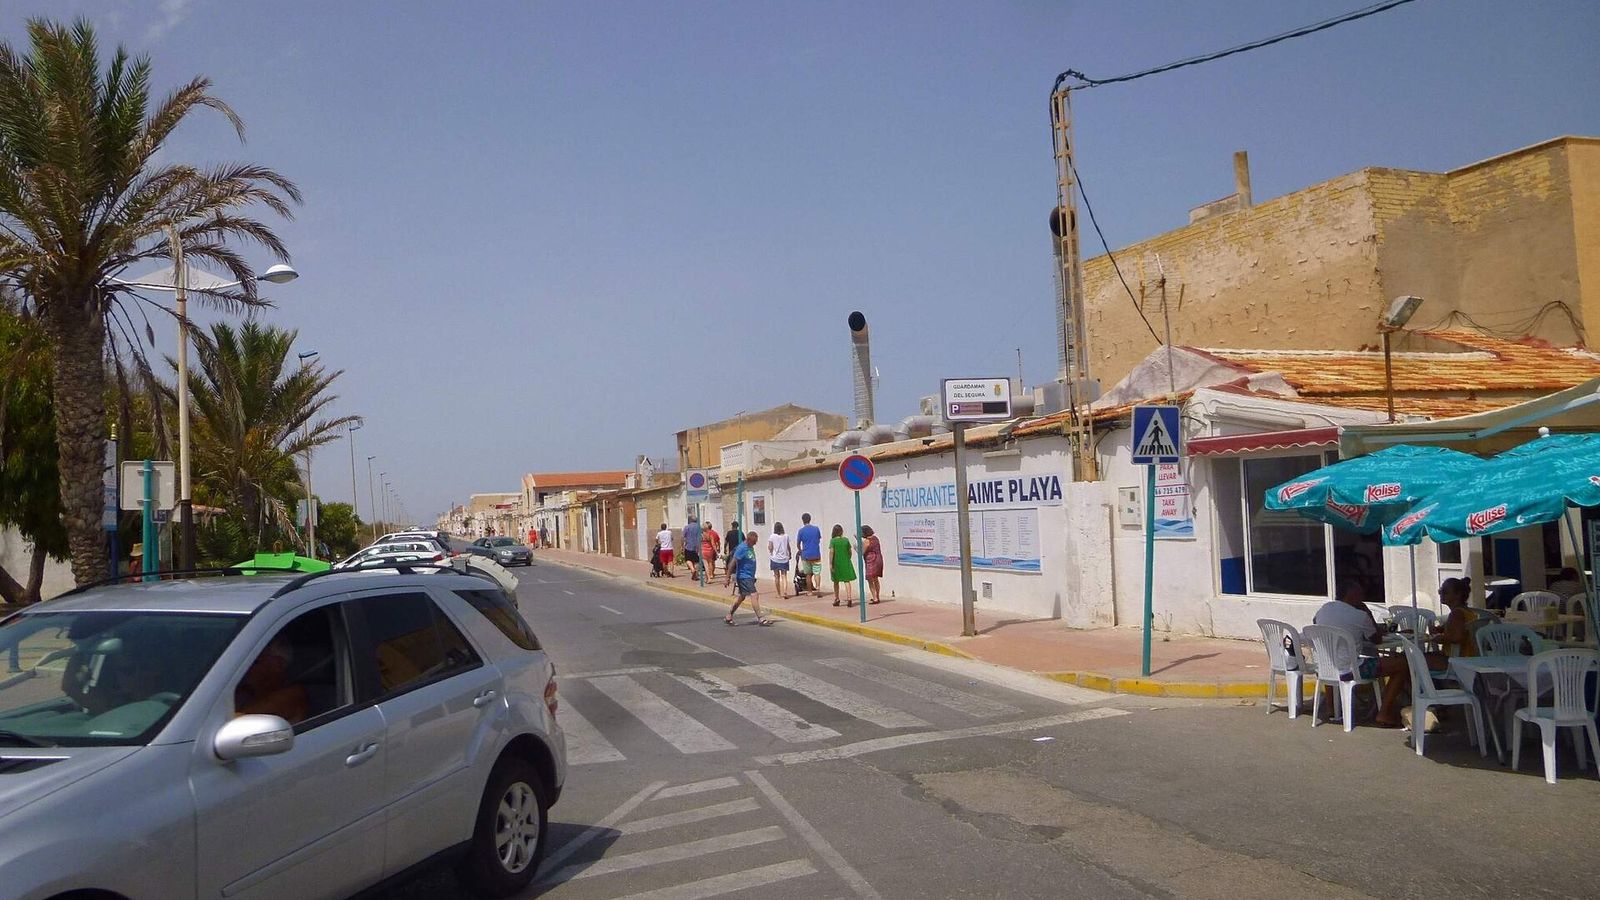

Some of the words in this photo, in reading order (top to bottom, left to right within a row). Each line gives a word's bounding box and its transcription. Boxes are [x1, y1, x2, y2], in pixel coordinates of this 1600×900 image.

[952, 404, 959, 413] P
[881, 485, 956, 509] RESTAURANTE
[968, 480, 1004, 505] AIME
[1008, 475, 1063, 502] PLAYA
[1367, 484, 1401, 503] Kalise
[1162, 508, 1177, 516] AWAY
[1469, 506, 1506, 533] Kalise
